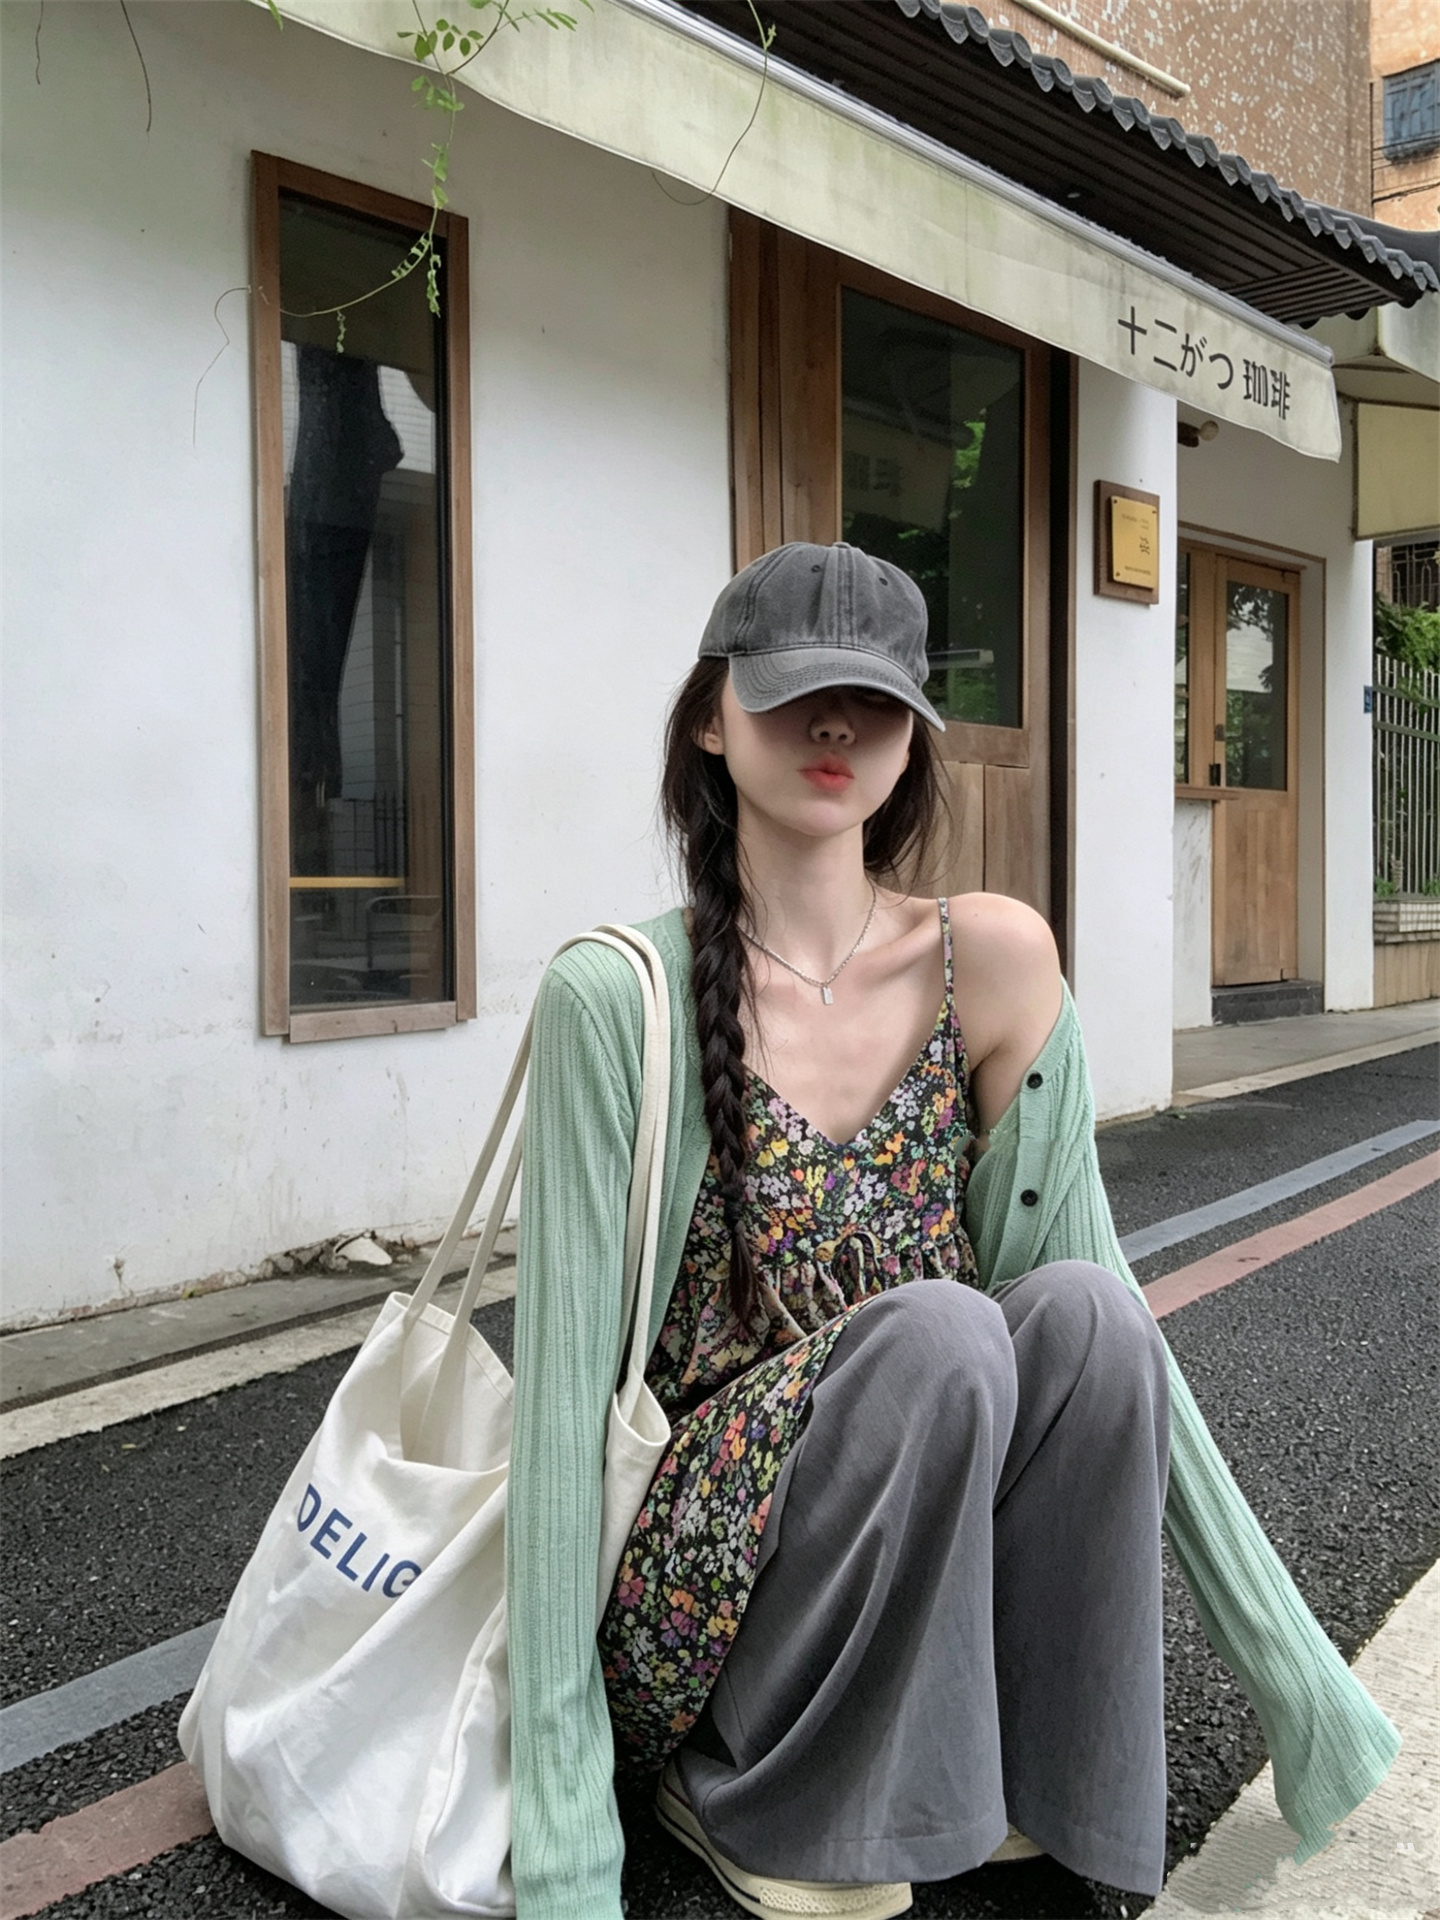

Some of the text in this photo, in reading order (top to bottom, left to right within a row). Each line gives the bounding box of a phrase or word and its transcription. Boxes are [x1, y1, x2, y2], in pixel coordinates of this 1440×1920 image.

[1118, 306, 1290, 420] 十二がつ 珈琲
